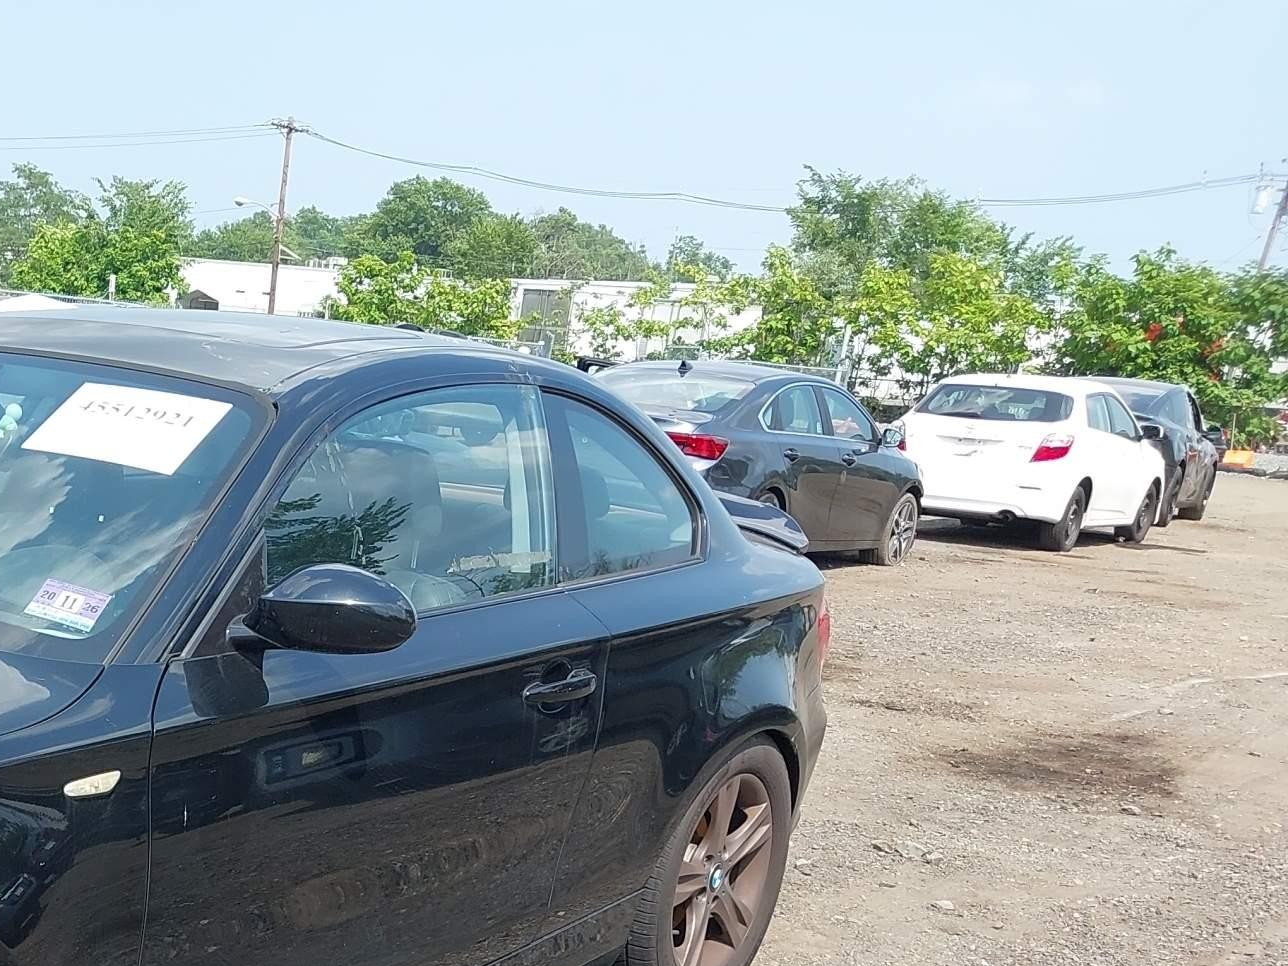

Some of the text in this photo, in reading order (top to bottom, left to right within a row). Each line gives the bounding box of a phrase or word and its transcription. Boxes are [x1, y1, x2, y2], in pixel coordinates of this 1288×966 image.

[79, 400, 194, 427] 45512921
[40, 590, 57, 601] 20
[58, 595, 78, 610] 11
[82, 602, 101, 614] 26
